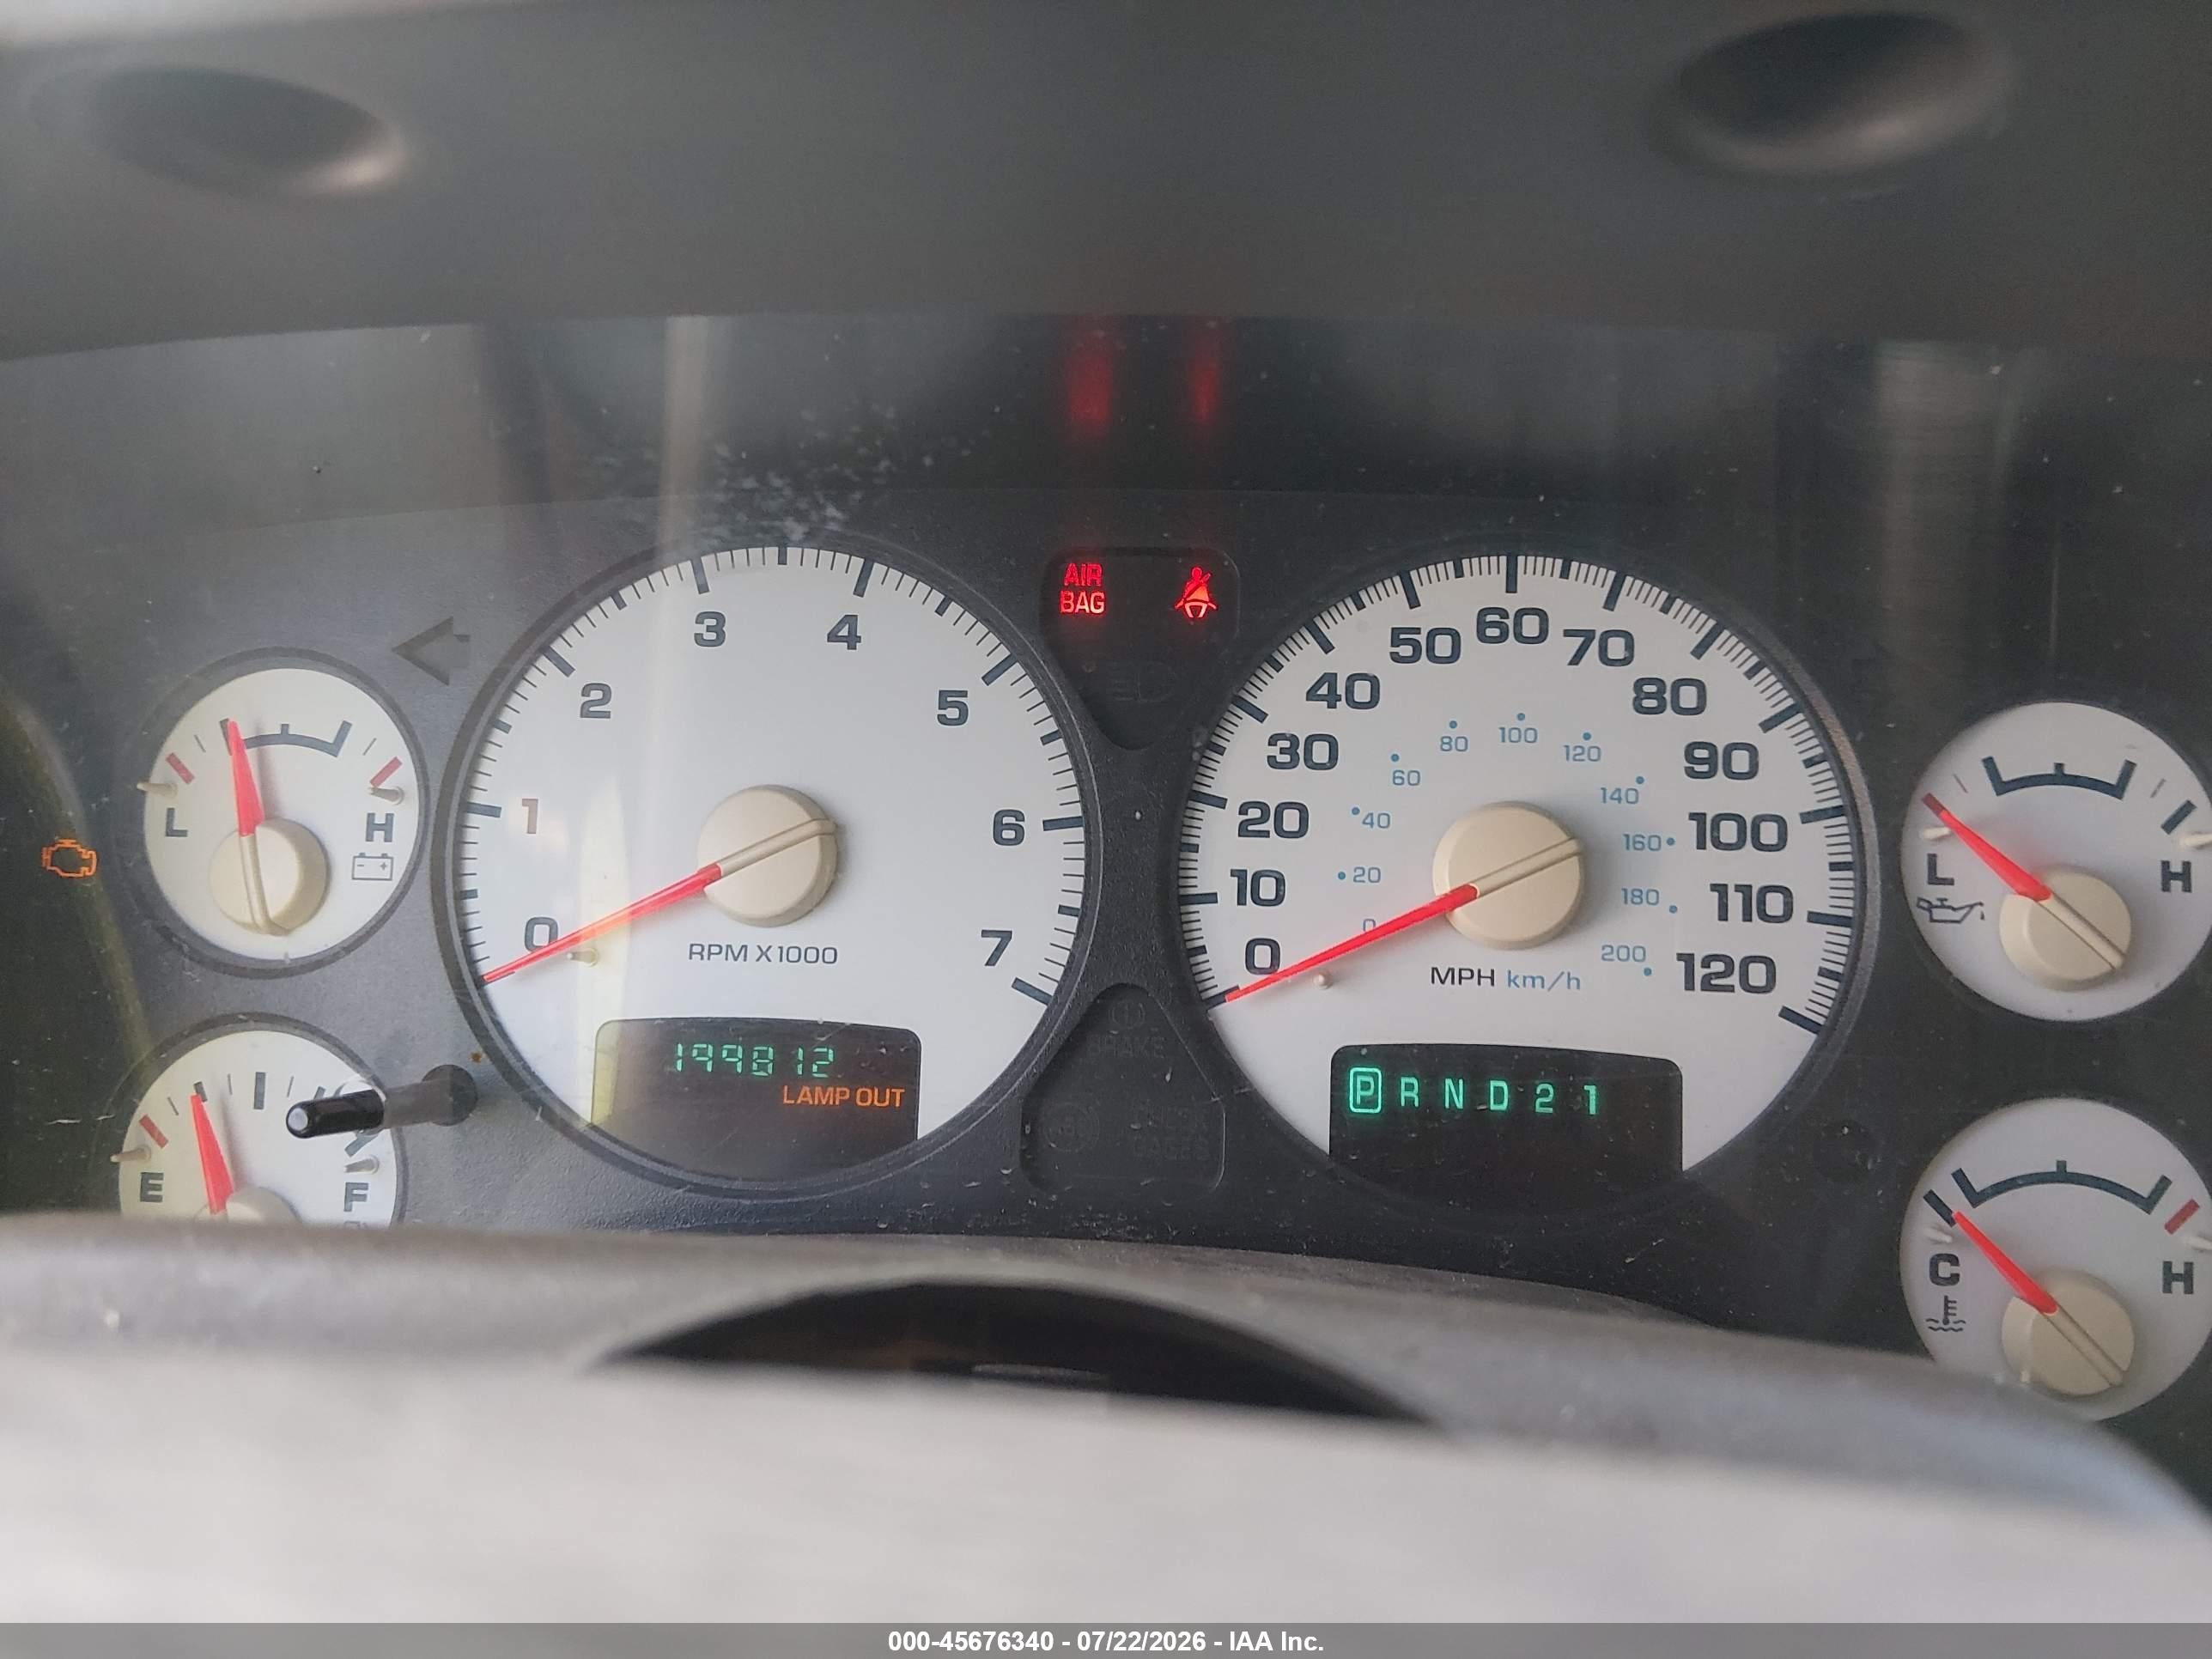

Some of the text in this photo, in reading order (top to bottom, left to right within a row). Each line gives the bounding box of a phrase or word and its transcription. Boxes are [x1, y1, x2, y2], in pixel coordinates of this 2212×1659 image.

[1064, 562, 1103, 586] AIR
[1059, 590, 1106, 614] BAG
[694, 611, 726, 647] 3
[827, 615, 861, 650] 4
[1476, 607, 1549, 644] 60
[1389, 627, 1461, 664] 50
[1564, 629, 1634, 666] 70
[580, 683, 611, 719] 2
[1306, 672, 1380, 709] 40
[1632, 678, 1706, 715] 80
[937, 690, 969, 726] 5
[1267, 733, 1339, 770] 30
[1439, 736, 1469, 752] 80
[1498, 727, 1538, 744] 100
[1563, 745, 1601, 763] 120
[1685, 741, 1759, 780] 90
[1392, 770, 1421, 787] 60
[1600, 787, 1639, 805] 140
[165, 807, 187, 837] L
[366, 812, 394, 843] H
[522, 799, 539, 834] 1
[993, 810, 1024, 846] 6
[1238, 801, 1309, 838] 20
[1361, 812, 1391, 830] 40
[1689, 812, 1788, 852] 100
[1623, 833, 1662, 852] 160
[1352, 866, 1382, 884] 20
[1927, 854, 1955, 886] L
[2160, 860, 2192, 893] H
[1231, 869, 1285, 907] 10
[1620, 887, 1660, 905] 180
[1710, 884, 1793, 923] 110
[525, 917, 558, 952] 0
[981, 930, 1012, 966] 7
[689, 943, 748, 963] RPM
[1245, 938, 1280, 975] 0
[1601, 945, 1647, 963] 200
[1431, 967, 1581, 992] MPH km/h
[1677, 953, 1776, 994] 120
[675, 1042, 835, 1079] 199812
[782, 1085, 906, 1109] LAMP OUT
[1356, 1075, 1597, 1115] P R N D 2 1
[139, 1171, 164, 1203] E
[343, 1182, 369, 1212] F
[1929, 1254, 1960, 1287] C
[2162, 1261, 2195, 1295] H
